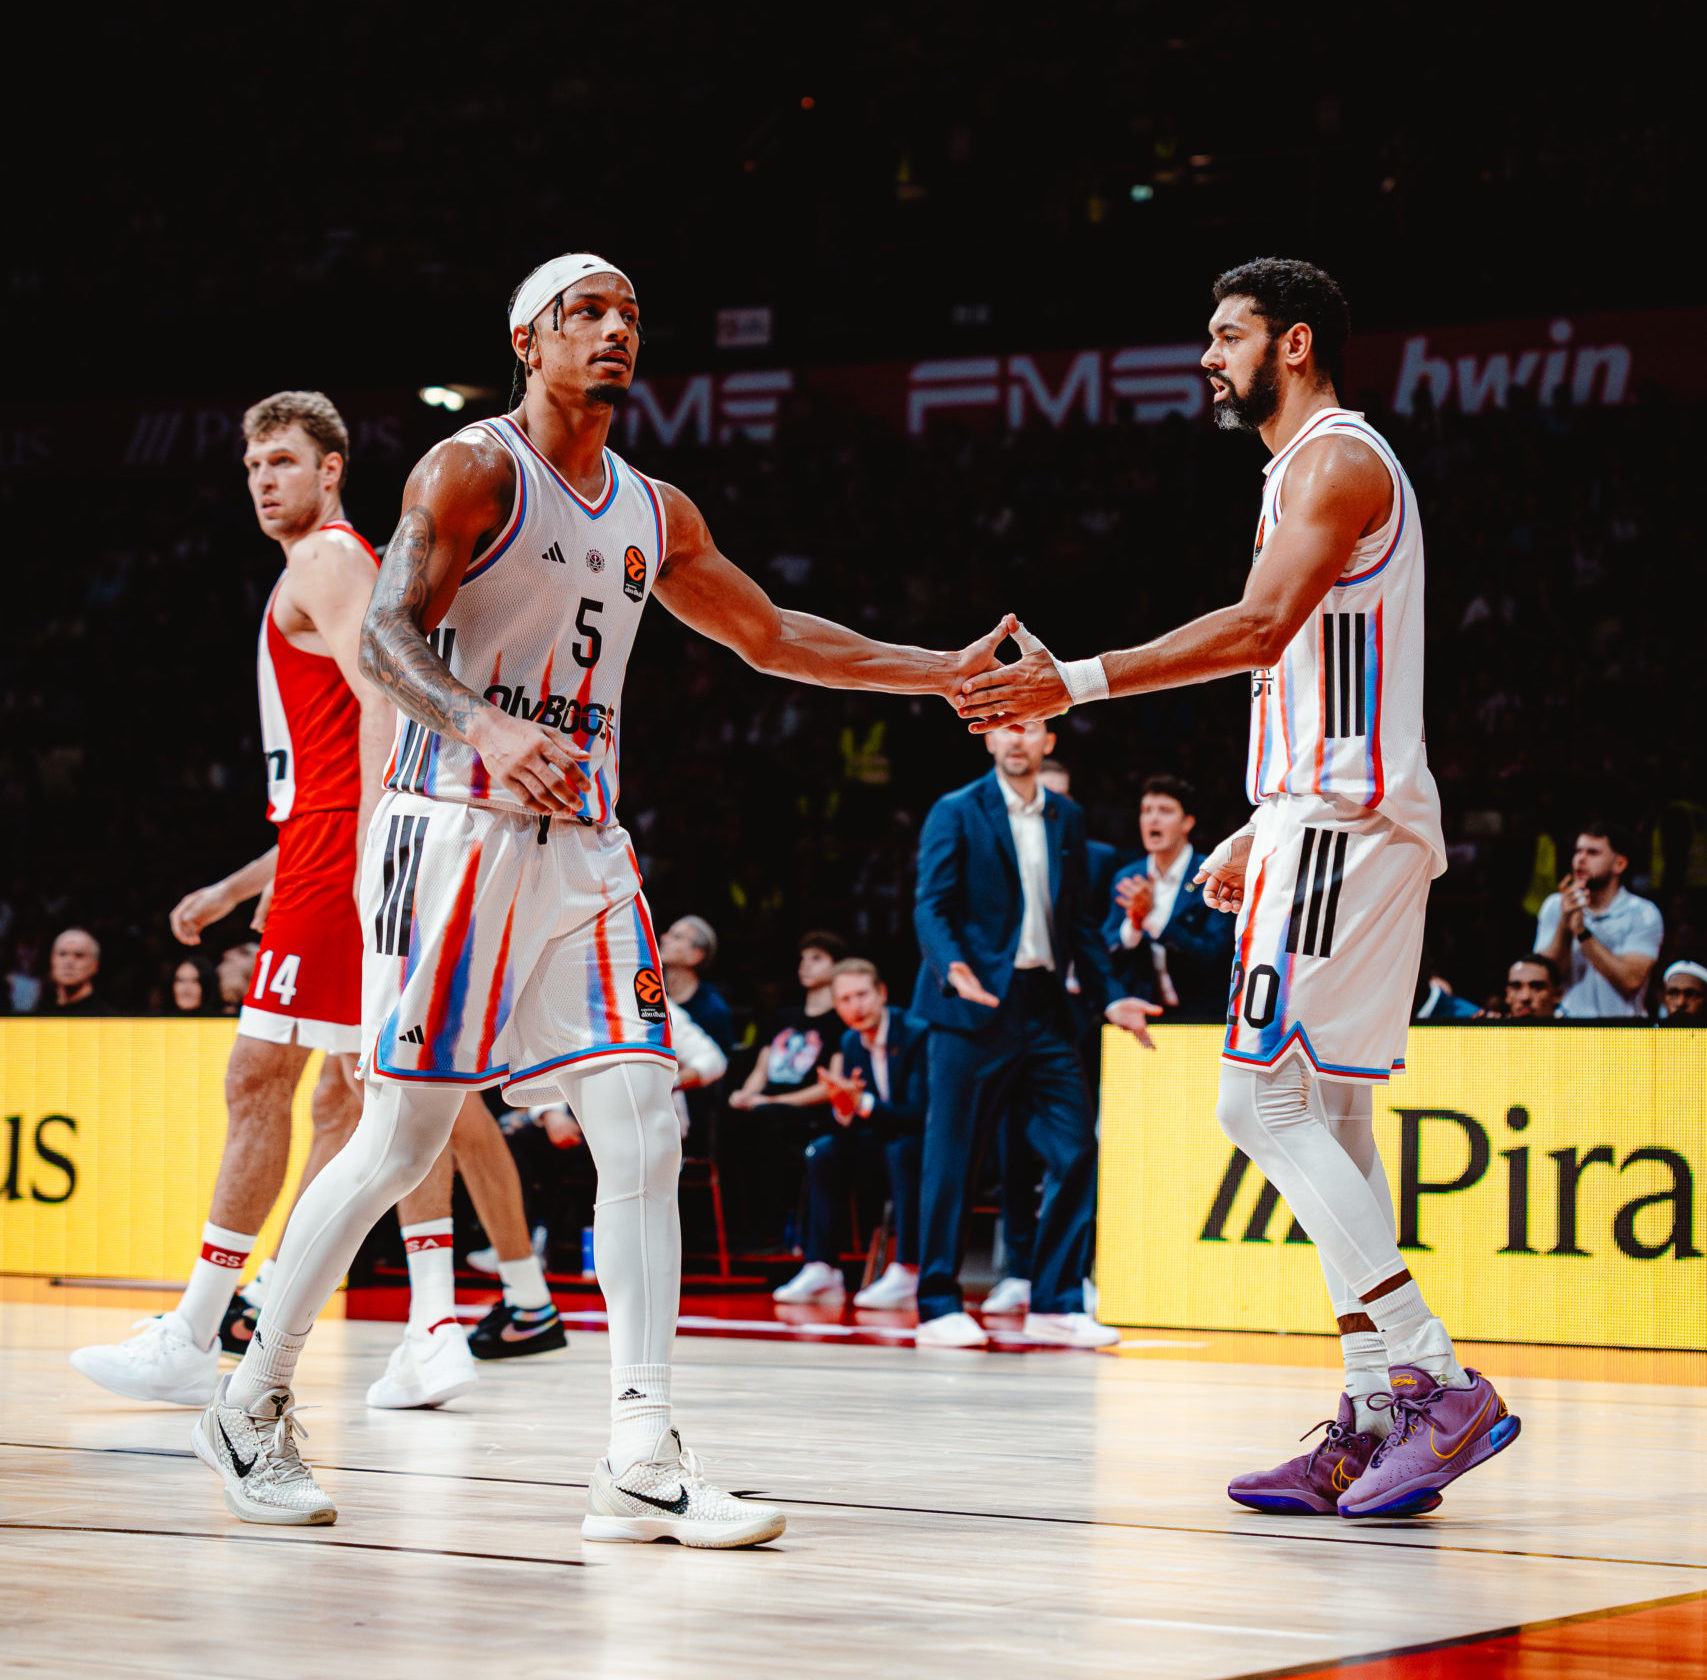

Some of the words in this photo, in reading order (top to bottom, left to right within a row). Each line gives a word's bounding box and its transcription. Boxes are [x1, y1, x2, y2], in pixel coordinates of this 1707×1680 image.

[1393, 316, 1632, 417] bwin
[571, 596, 604, 669] 5
[253, 949, 302, 1006] 14
[1228, 961, 1280, 1029] 20
[1390, 1104, 1704, 1260] Pira
[210, 1250, 246, 1268] GS
